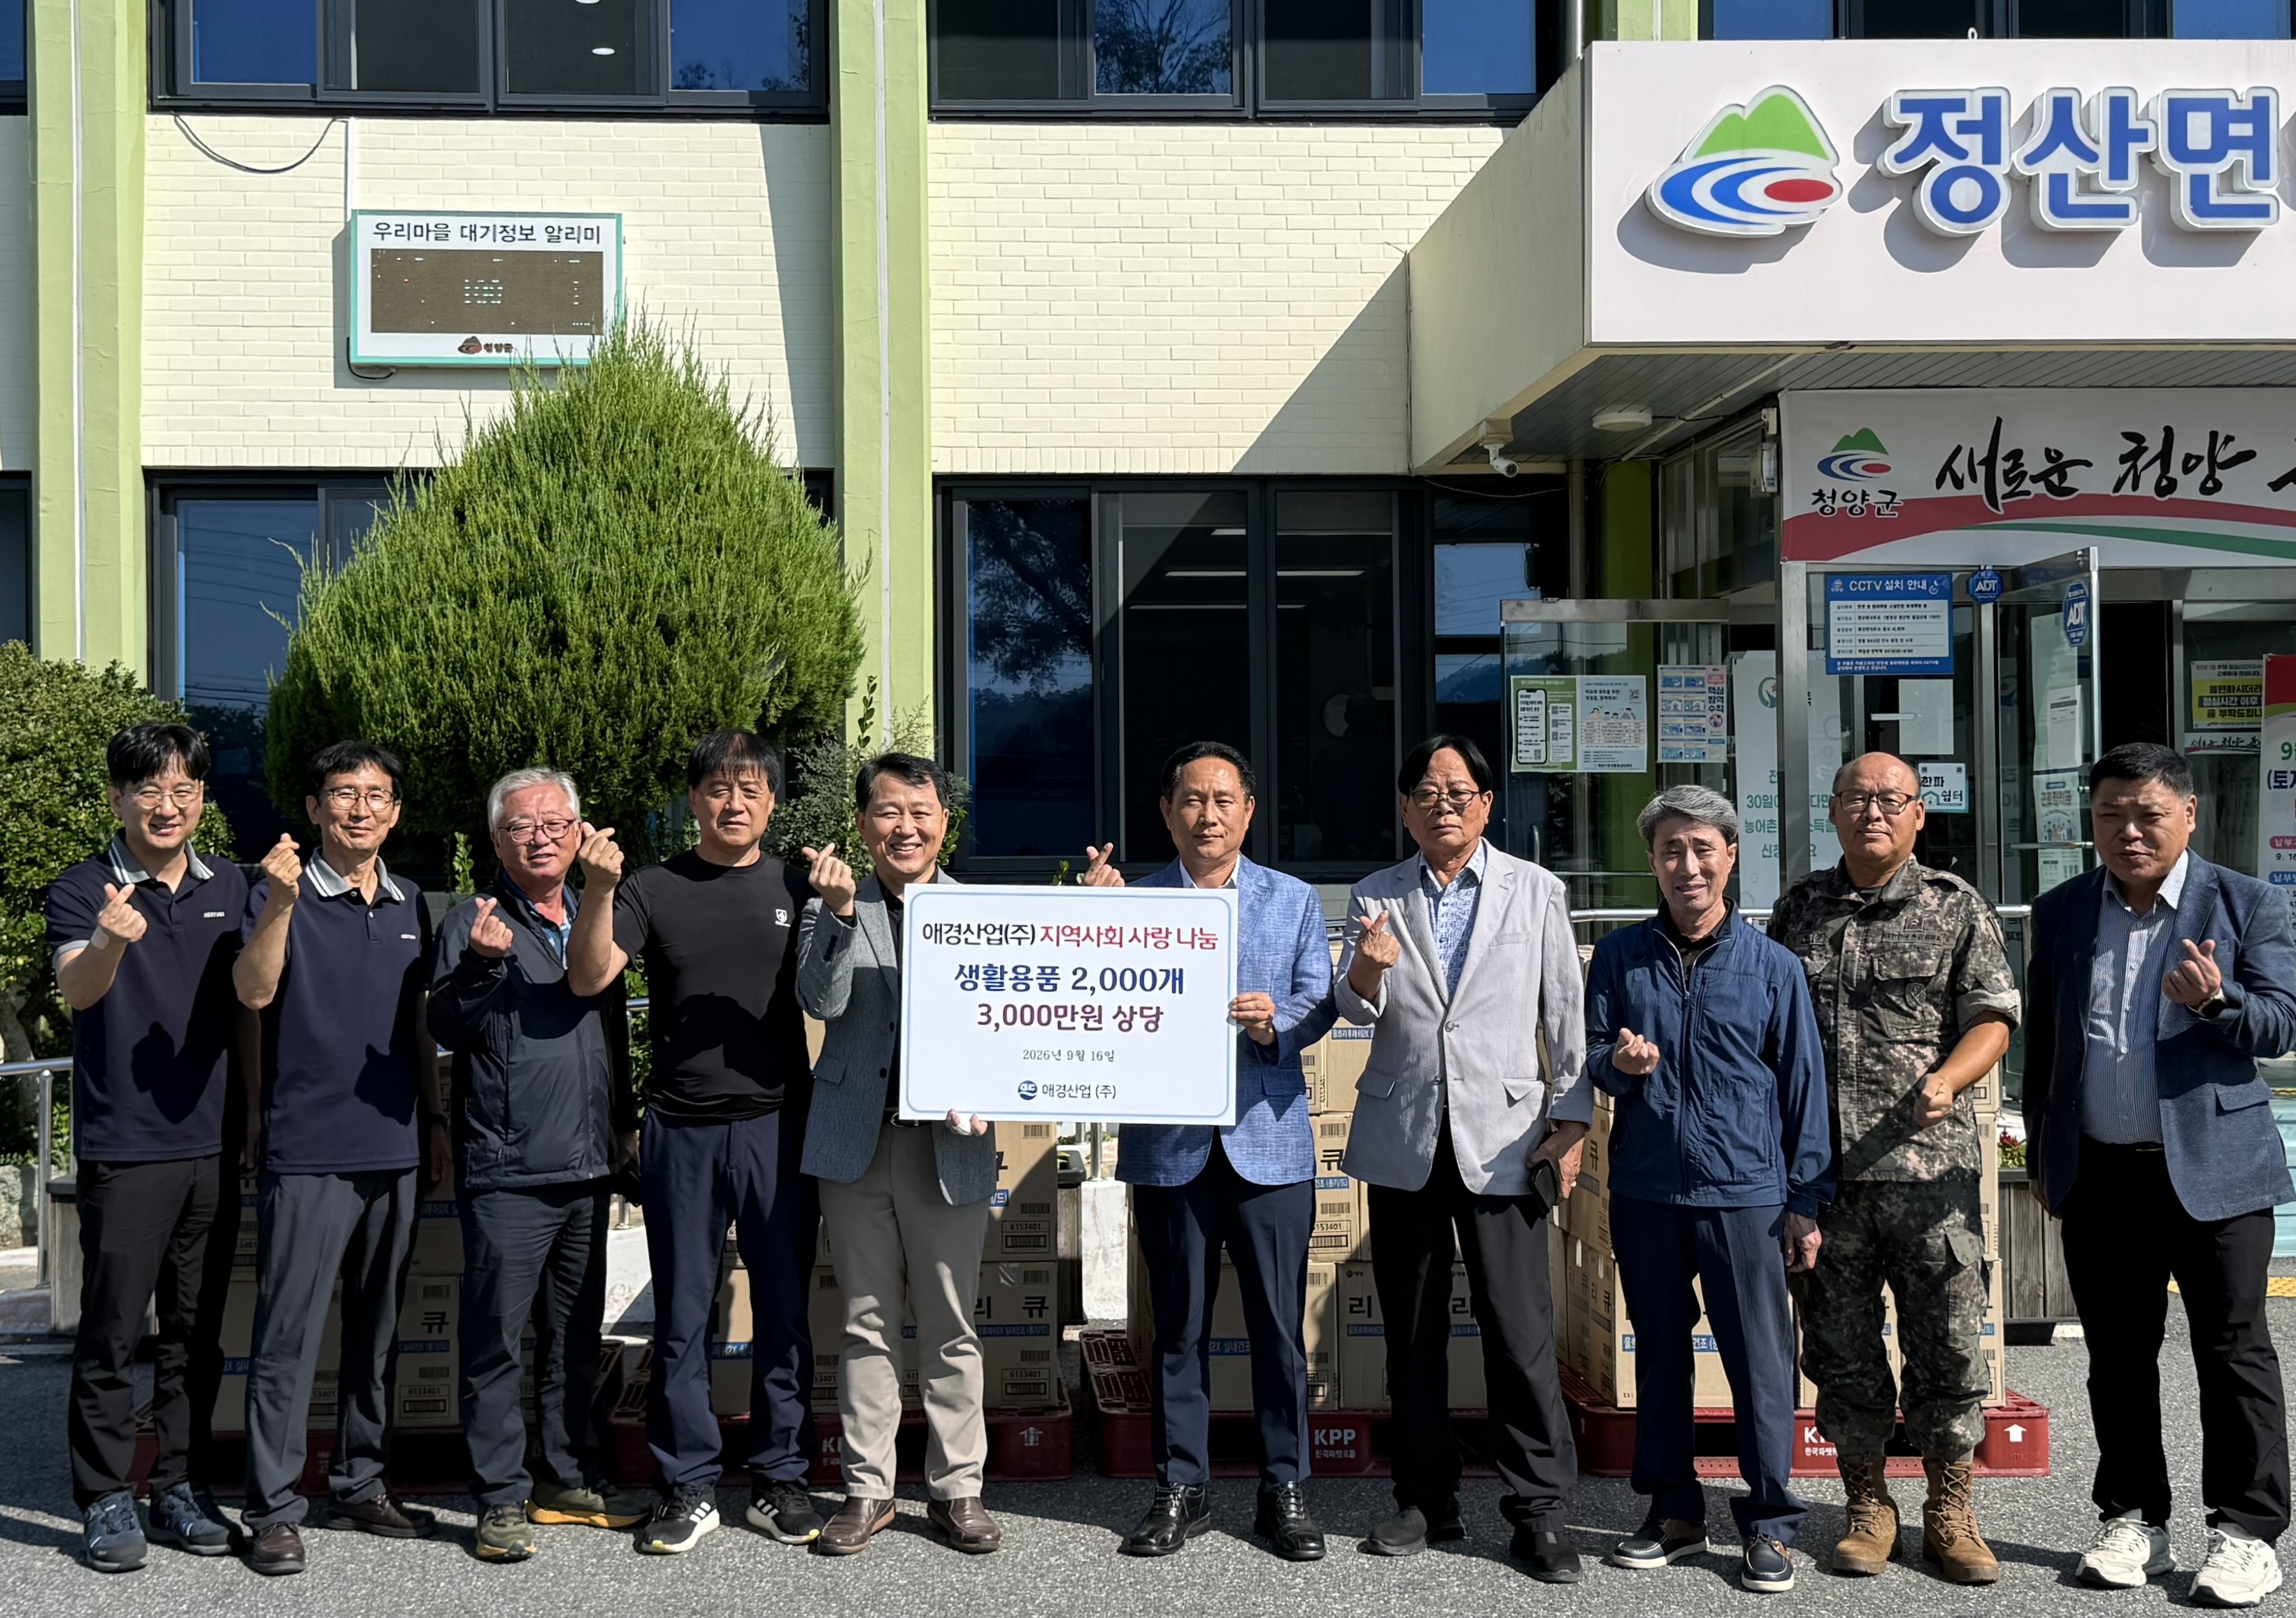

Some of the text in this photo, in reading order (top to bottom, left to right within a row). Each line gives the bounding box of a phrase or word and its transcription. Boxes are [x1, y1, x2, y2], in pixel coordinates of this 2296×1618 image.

[1890, 92, 2275, 229] 정산면
[373, 222, 600, 244] 우리마을 대기정보 알리미
[1936, 416, 2092, 514] 새로운
[2112, 425, 2257, 499] 청양
[1811, 488, 1902, 517] 청양군
[1849, 579, 1927, 591] CCTV 설치 안내
[1975, 580, 1997, 592] ADT
[2067, 601, 2085, 627] ADT
[2240, 697, 2258, 706] 이후
[2281, 741, 2296, 760] 9
[1921, 776, 1944, 787] 한파
[1941, 790, 1962, 802] 쉼터
[1745, 819, 1777, 834] 농어촌
[922, 923, 1218, 951] 애경산업(주) 지역사회 사랑 나눔
[954, 963, 1185, 996] 생활용품 2,000개
[978, 1004, 1164, 1032] 3,000만원 상당
[1022, 1049, 1115, 1063] 2026년 9월 16일
[1042, 1084, 1090, 1098] 애경산업
[1096, 1084, 1115, 1099] (주)
[1320, 1149, 1343, 1170] 큐
[1022, 1296, 1050, 1318] 큐
[1349, 1296, 1372, 1318] 리
[1452, 1296, 1474, 1318] 리
[421, 1312, 449, 1333] 큐
[1314, 1428, 1356, 1445] KPP
